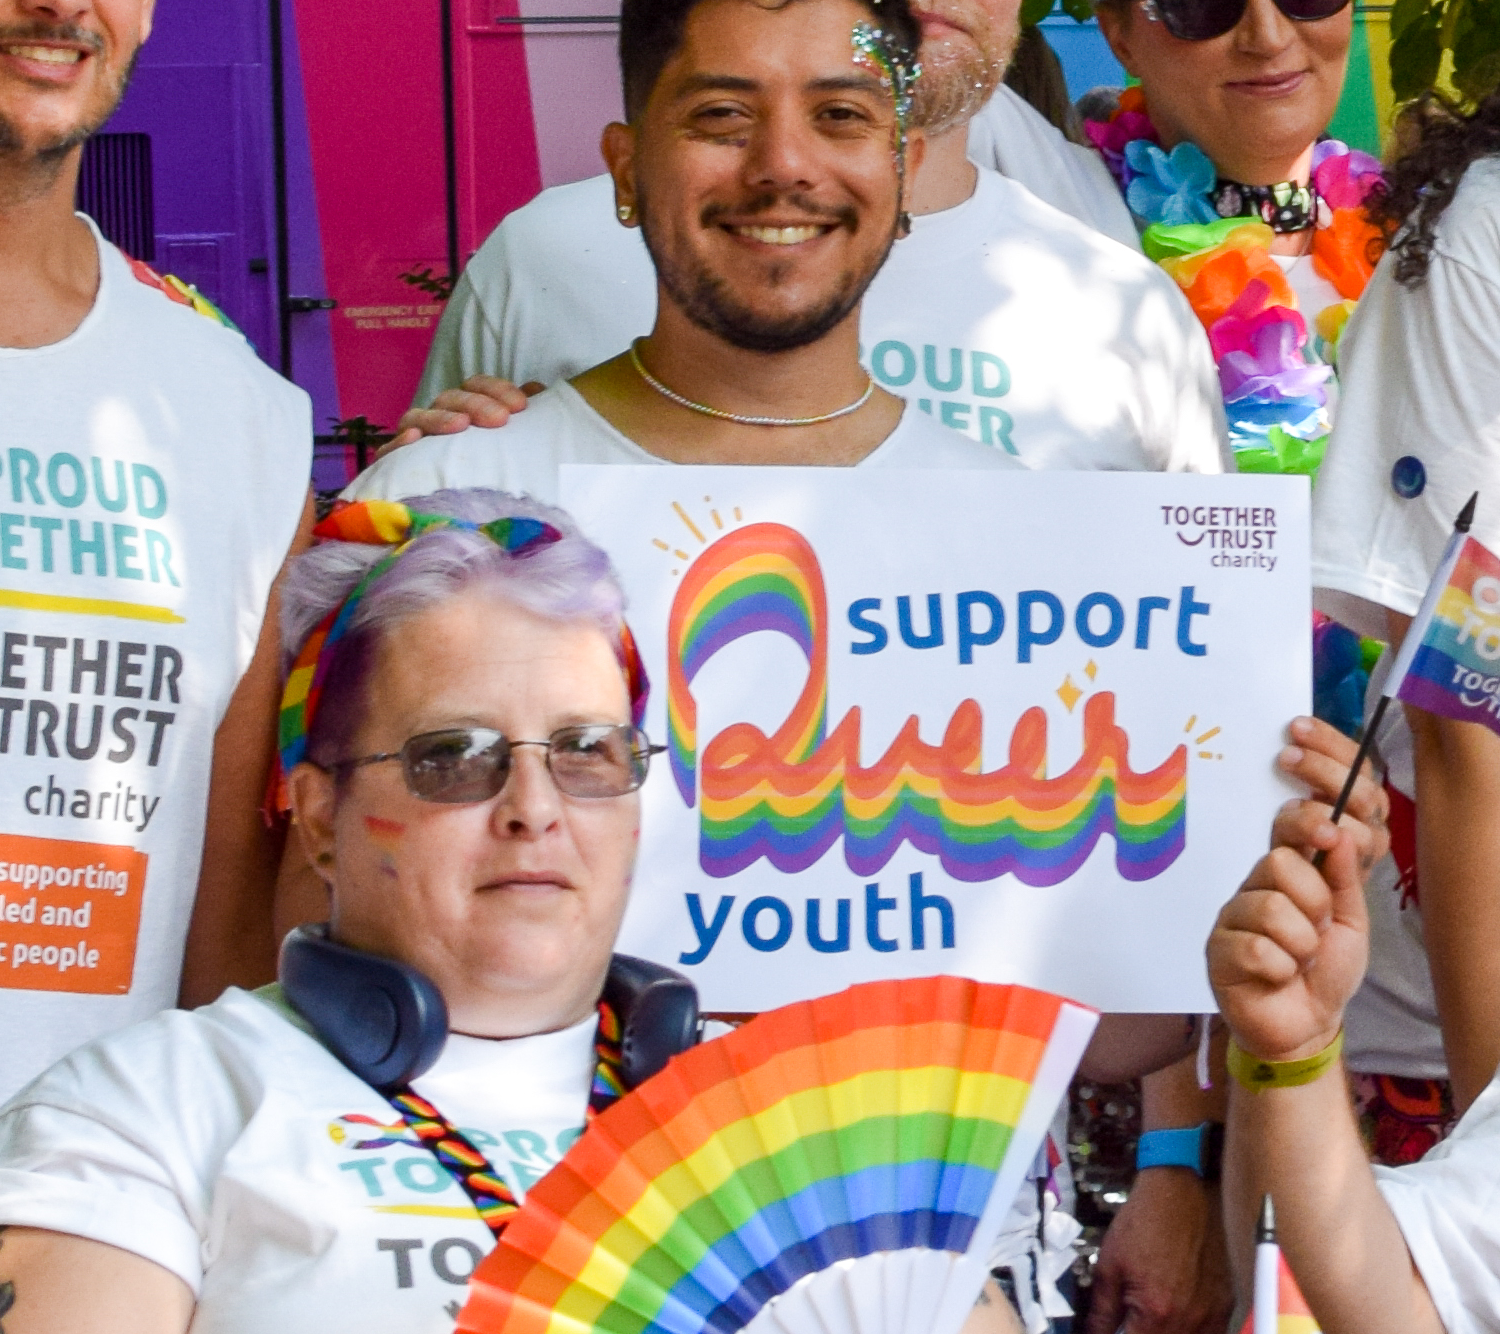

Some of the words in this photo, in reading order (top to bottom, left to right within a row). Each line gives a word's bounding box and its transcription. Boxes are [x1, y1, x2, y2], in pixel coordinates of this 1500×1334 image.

[861, 338, 1013, 401] OUD
[1161, 505, 1278, 528] TOGETHER
[1207, 529, 1277, 549] TRUST
[1211, 550, 1278, 572] charity
[849, 586, 1211, 665] support
[667, 522, 1188, 887] Queer
[24, 776, 160, 832] charity
[41, 901, 91, 928] and
[679, 873, 957, 965] youth
[12, 941, 99, 971] people
